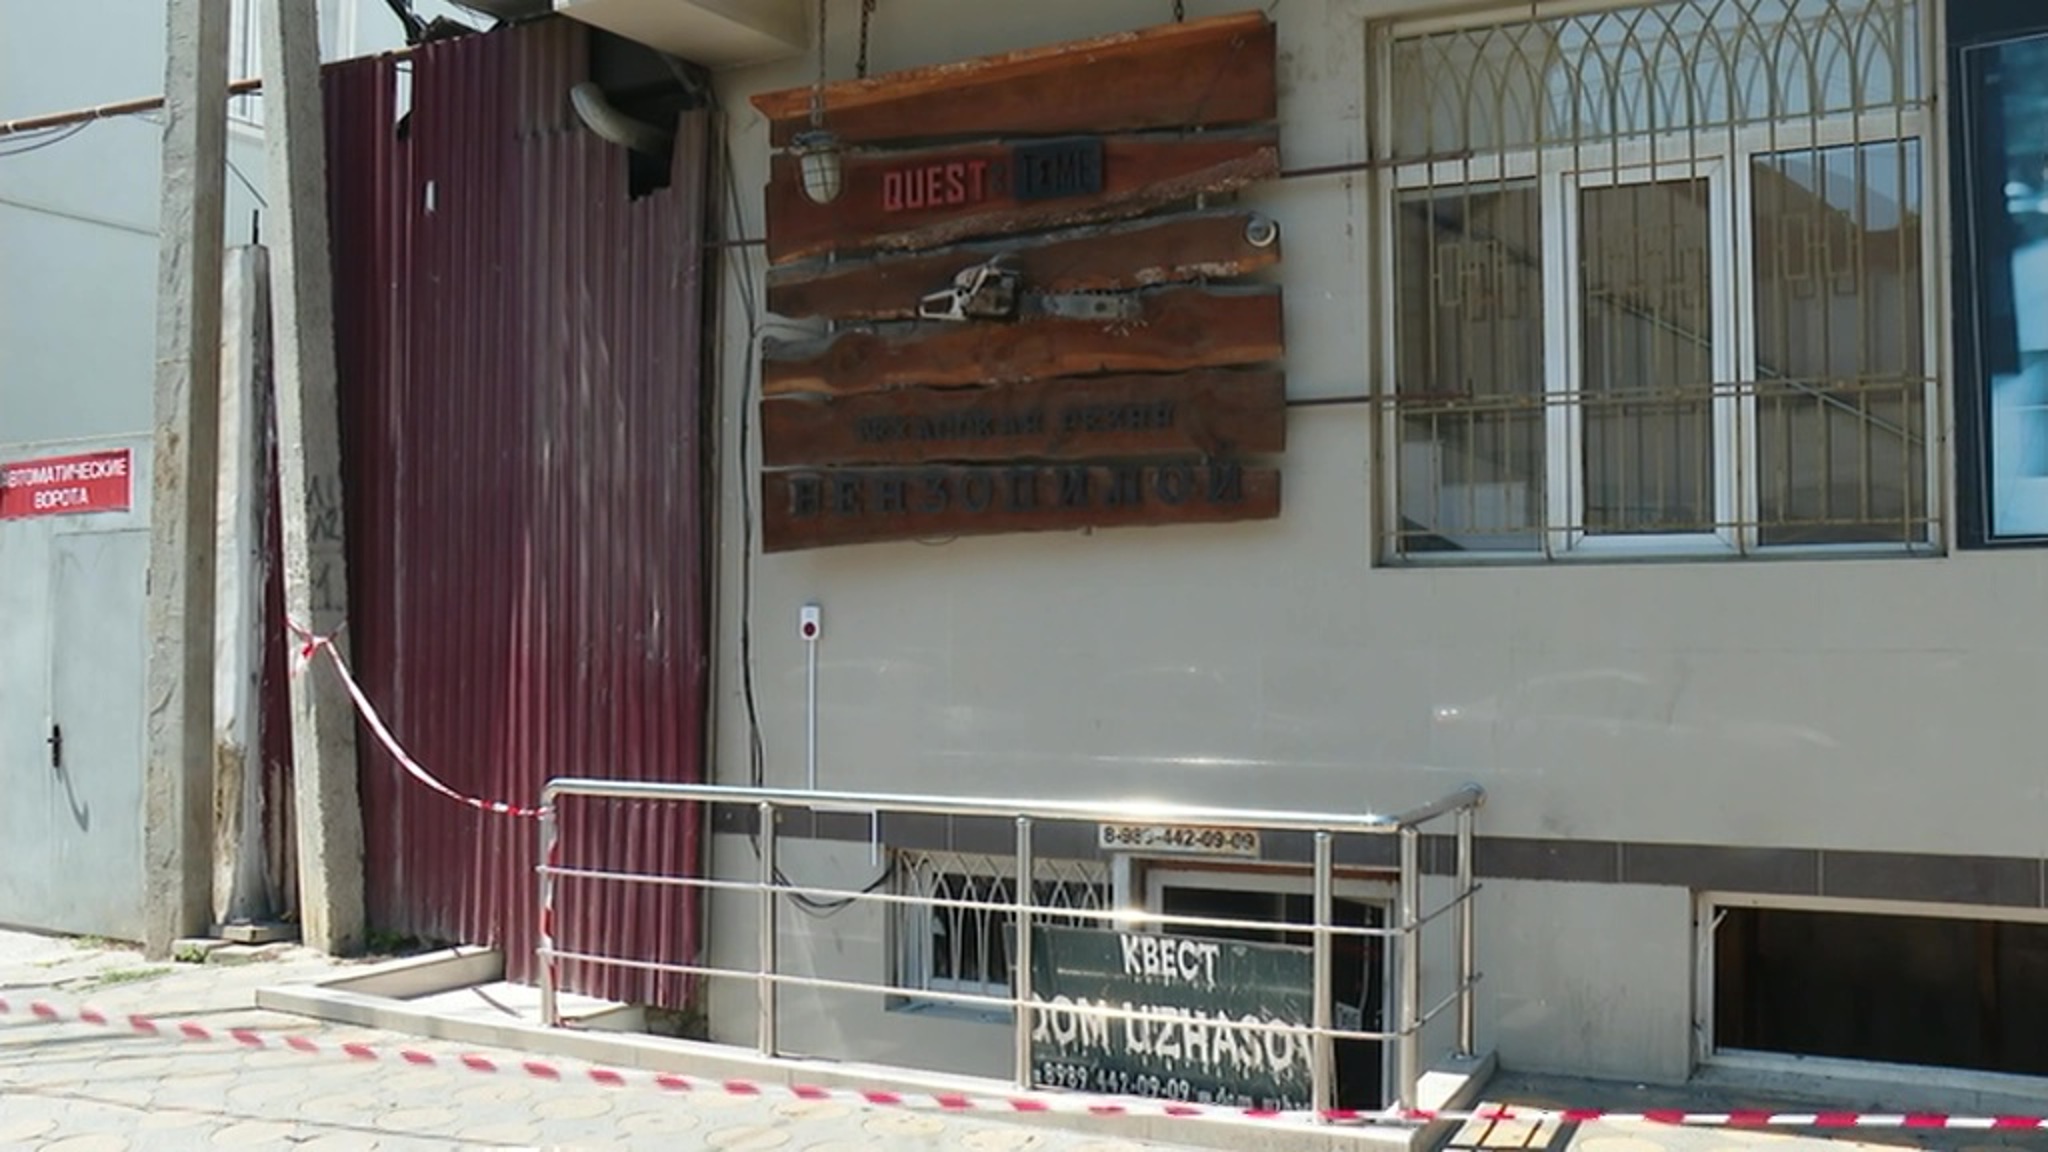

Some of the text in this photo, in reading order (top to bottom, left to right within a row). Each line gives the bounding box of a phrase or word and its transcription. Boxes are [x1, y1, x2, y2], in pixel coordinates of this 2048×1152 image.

[882, 159, 988, 212] QUEST
[33, 487, 89, 509] ВОРОТА
[1120, 934, 1220, 988] КВЕСТ
